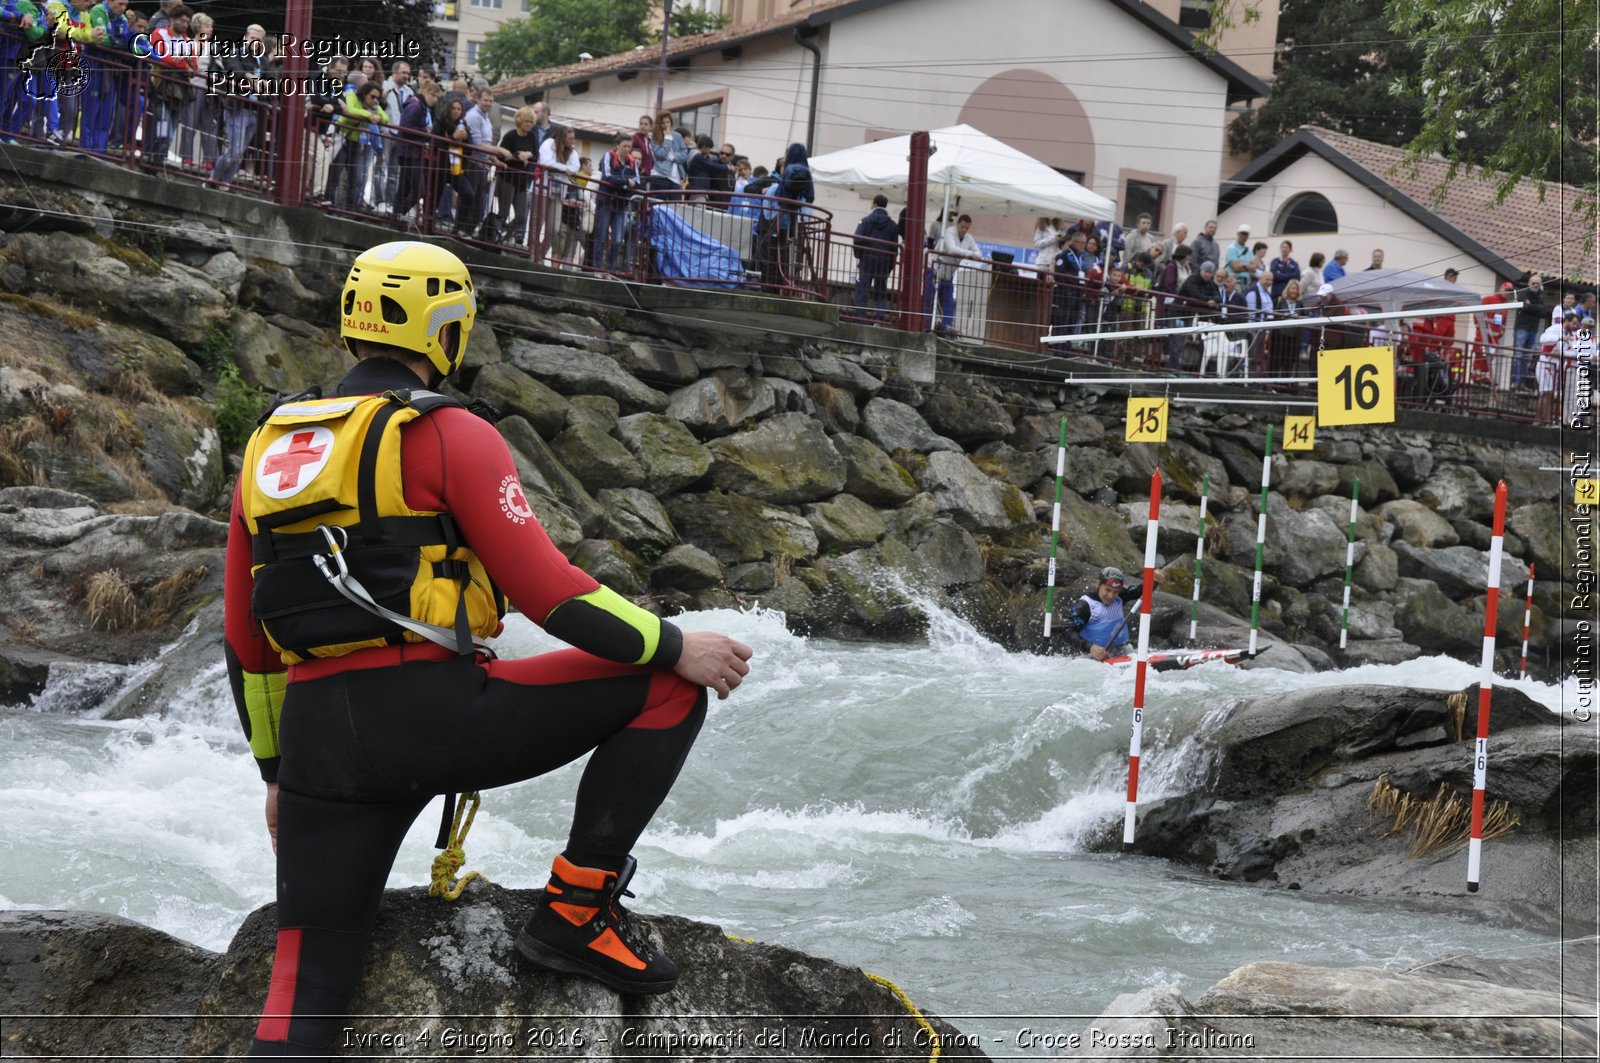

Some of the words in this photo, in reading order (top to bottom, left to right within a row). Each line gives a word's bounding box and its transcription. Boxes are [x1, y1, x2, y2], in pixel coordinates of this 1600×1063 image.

[359, 321, 390, 334] O.P.S.A.
[1335, 363, 1380, 411] 16
[1135, 406, 1159, 434] 15
[1290, 423, 1309, 444] 14
[498, 497, 526, 525] CROCE
